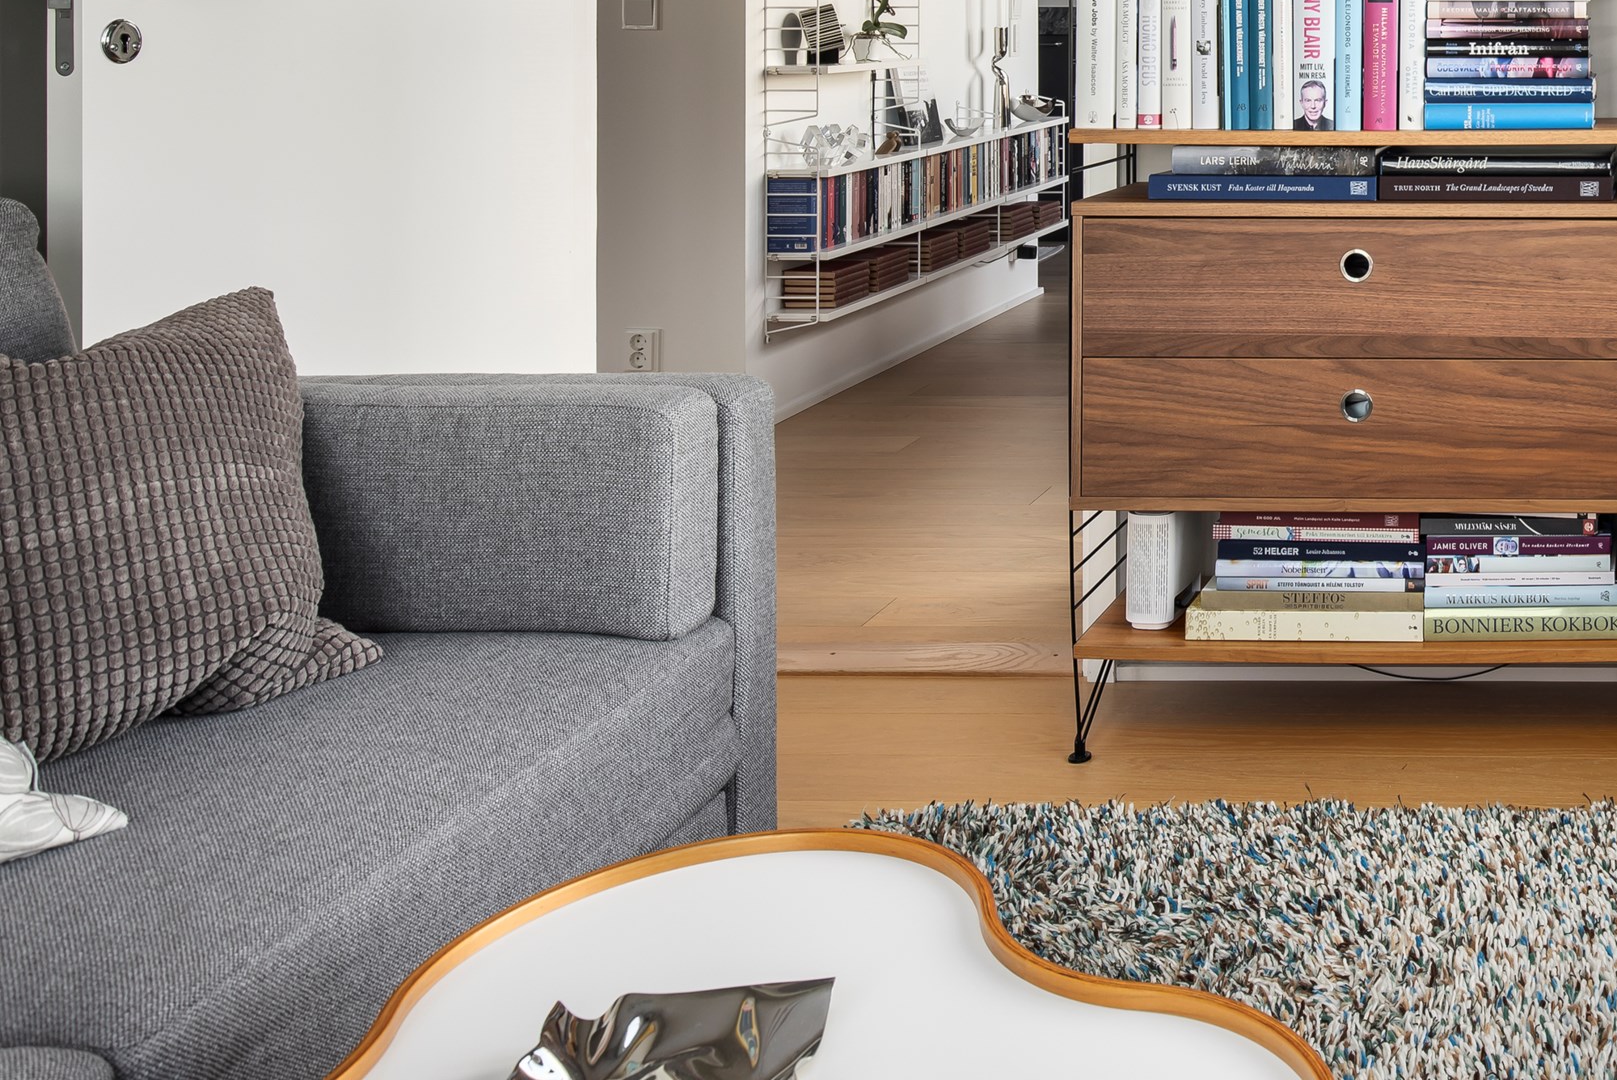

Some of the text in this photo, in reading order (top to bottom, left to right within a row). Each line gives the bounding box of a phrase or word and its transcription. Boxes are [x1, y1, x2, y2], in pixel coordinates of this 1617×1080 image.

[1091, 8, 1099, 26] Jobs
[1408, 1, 1416, 50] HISTORIA
[1089, 28, 1098, 37] by
[1303, 17, 1321, 59] BLAIR
[1142, 15, 1157, 87] HOMO DEUS
[1469, 42, 1529, 56] Inifrån
[1300, 63, 1313, 71] MITT
[1200, 156, 1257, 166] LARS LERIN
[1395, 156, 1488, 174] HavsSkärgård
[1167, 183, 1315, 193] SVENSK KUST Från Koster till Haparanda
[1446, 183, 1458, 192] The
[1459, 183, 1481, 192] Grand
[1482, 183, 1519, 193] Landscapes
[1520, 183, 1528, 193] of
[1528, 183, 1553, 192] Sweden
[1253, 547, 1299, 555] 52 HELGER
[1459, 542, 1488, 550] OLIVER
[1245, 579, 1269, 589] SPRIT
[1446, 594, 1550, 605] MARKUS KOKBOK
[1433, 617, 1535, 634] BONNIERS
